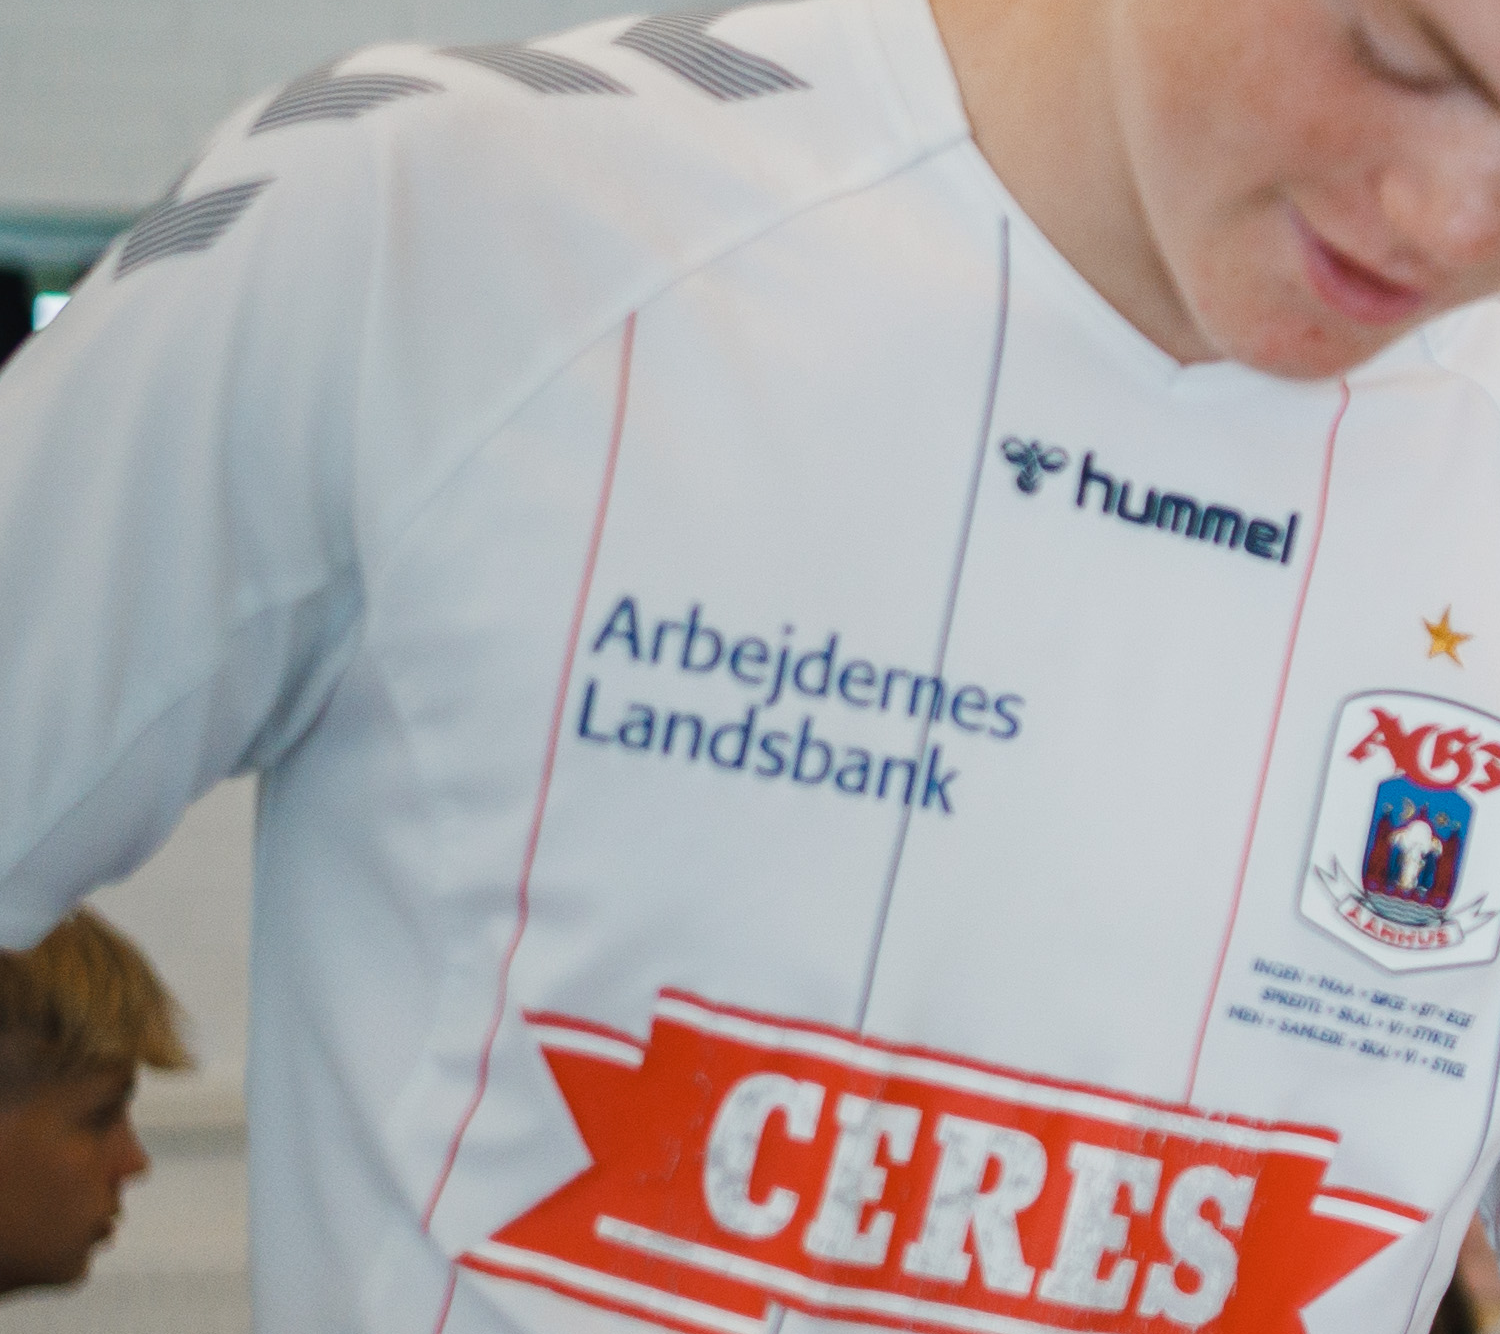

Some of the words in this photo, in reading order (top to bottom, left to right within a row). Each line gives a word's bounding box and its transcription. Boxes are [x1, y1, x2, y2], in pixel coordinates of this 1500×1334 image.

[1075, 451, 1300, 565] hummel
[591, 594, 1026, 740] Arbejdernes
[577, 676, 959, 815] Landsbank
[1345, 905, 1451, 947] AARHUS
[703, 1071, 1257, 1328] CERES
